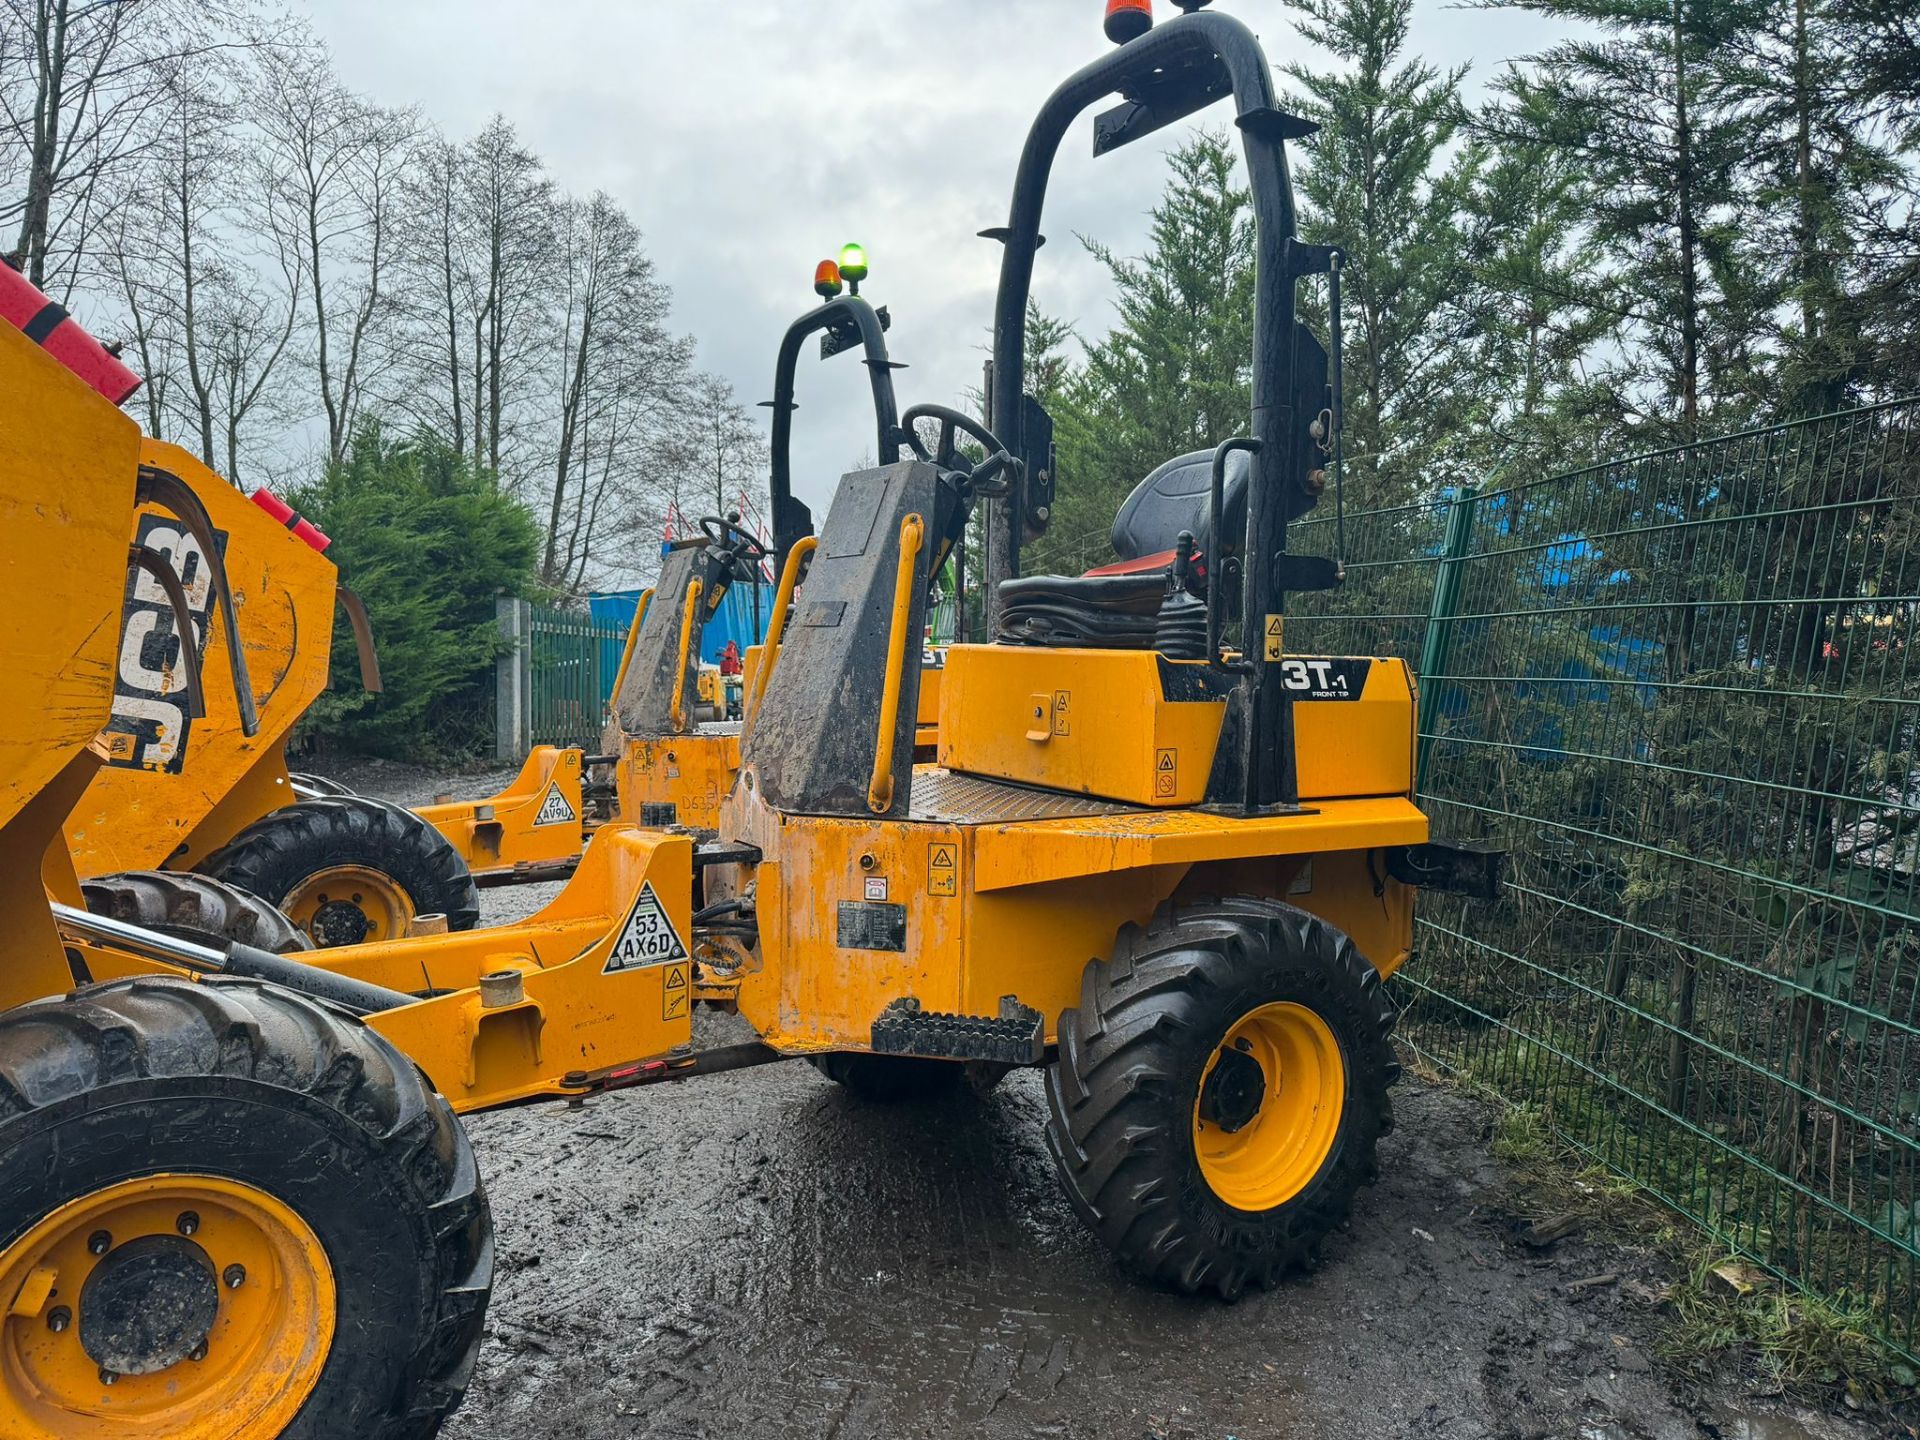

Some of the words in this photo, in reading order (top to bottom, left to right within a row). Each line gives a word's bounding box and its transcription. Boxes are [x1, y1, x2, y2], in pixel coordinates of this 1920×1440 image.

[111, 527, 212, 771] JCB
[543, 807, 568, 820] AV9U
[549, 797, 561, 808] 27
[636, 913, 658, 936] 53
[623, 933, 670, 960] AX6D
